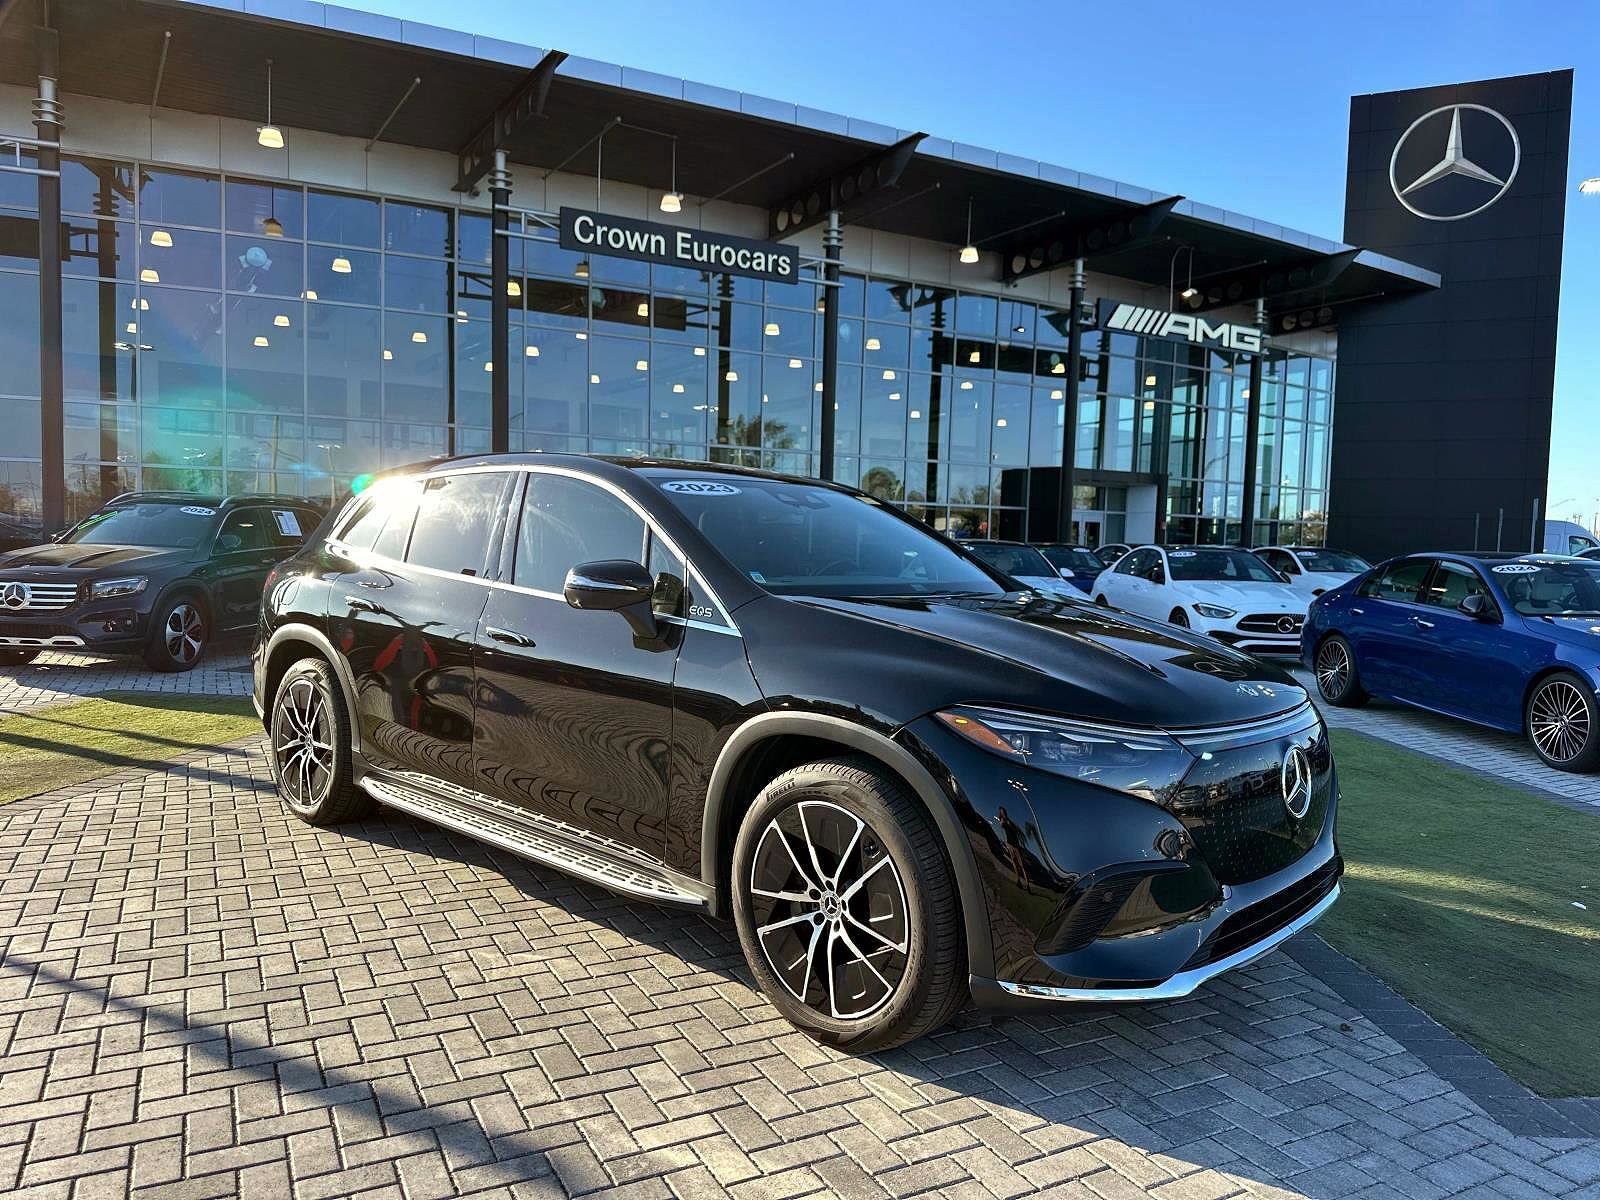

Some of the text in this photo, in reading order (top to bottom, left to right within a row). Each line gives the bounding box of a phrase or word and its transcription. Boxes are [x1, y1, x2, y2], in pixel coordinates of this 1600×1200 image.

[573, 215, 791, 276] Crown Eurocars
[669, 483, 735, 493] 2023
[689, 605, 713, 618] EQS
[766, 778, 796, 802] PIRELLI
